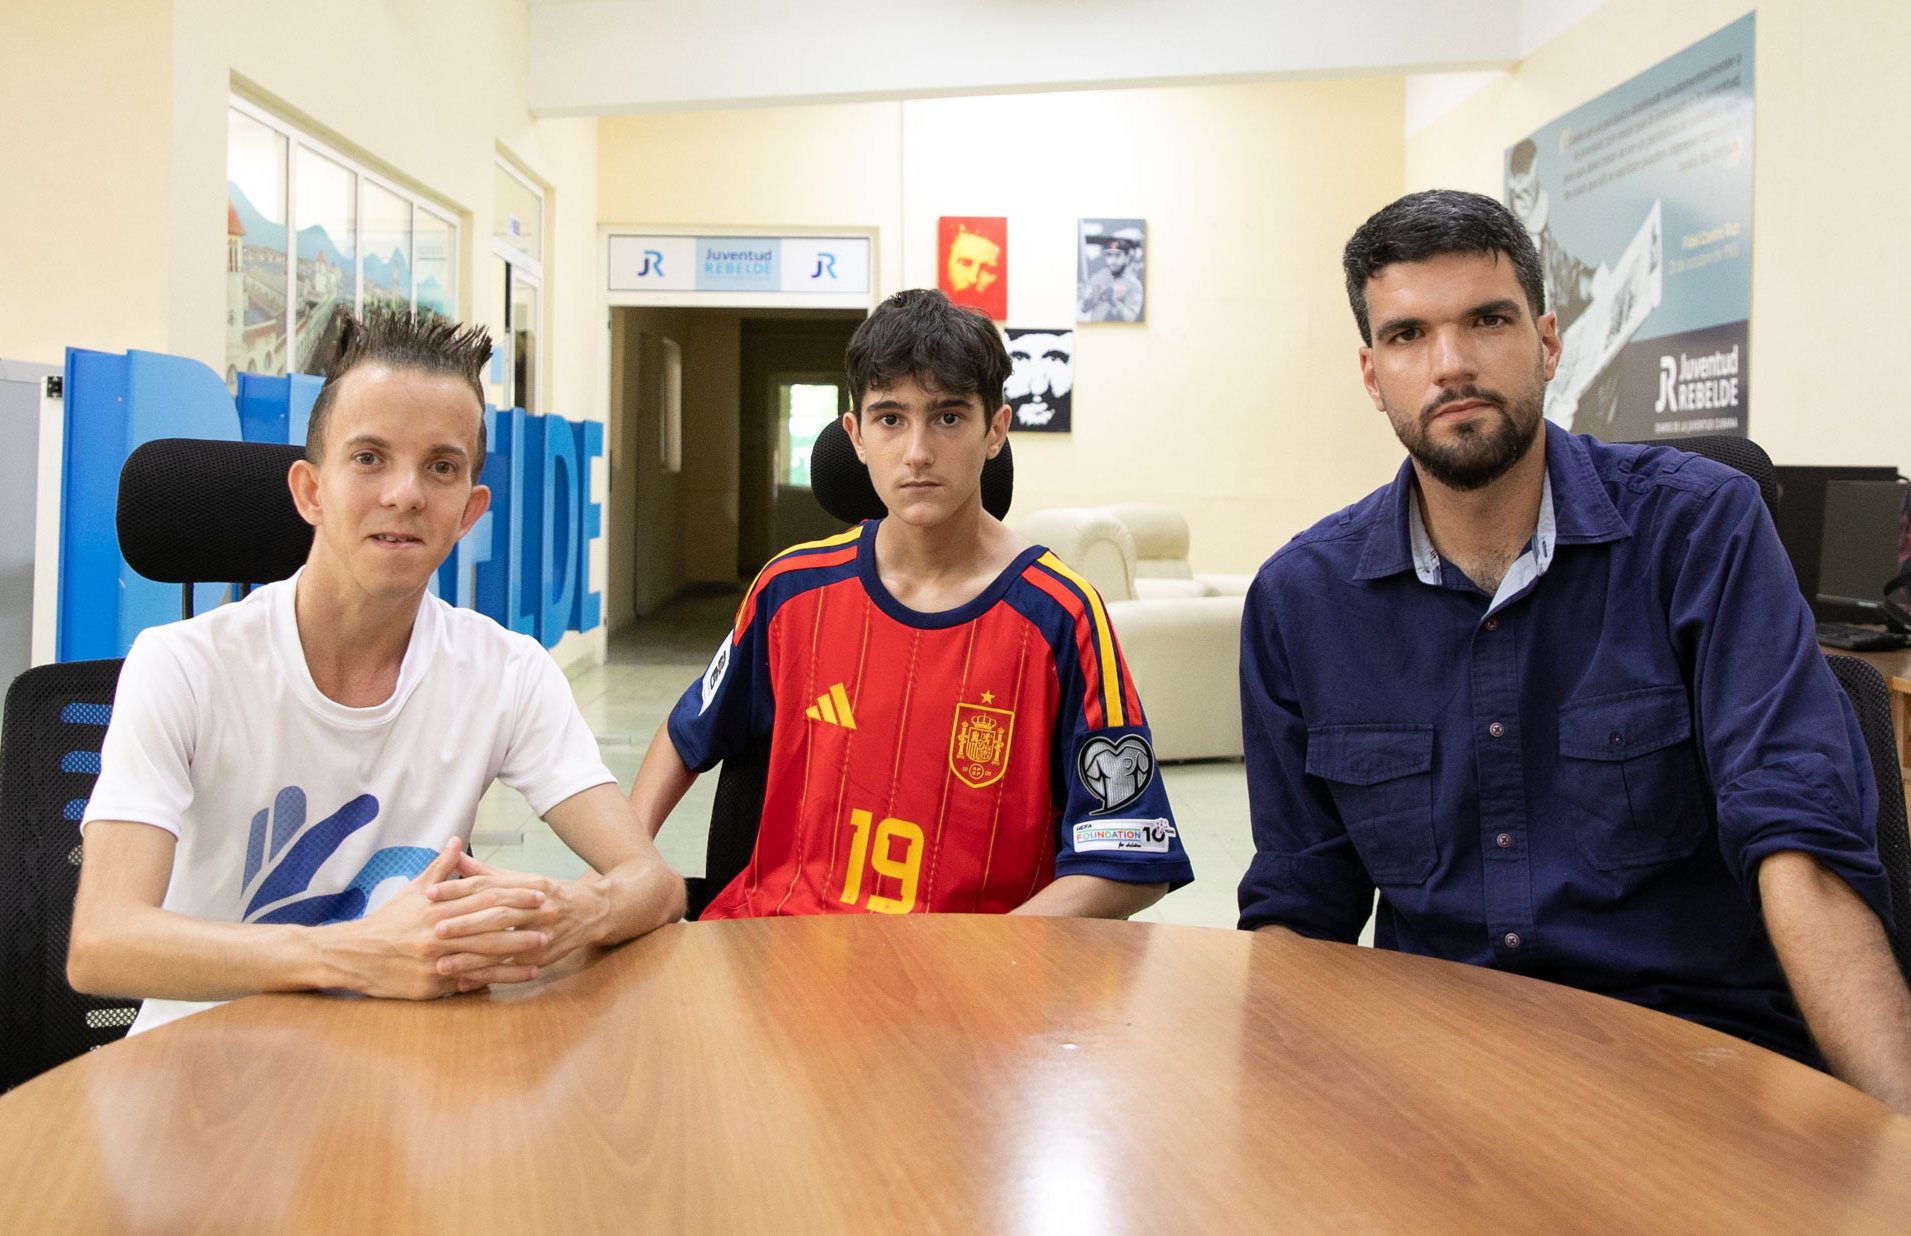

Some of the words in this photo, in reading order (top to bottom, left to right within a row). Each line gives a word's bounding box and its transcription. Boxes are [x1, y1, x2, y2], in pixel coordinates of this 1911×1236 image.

[705, 248, 773, 261] Juventud
[704, 262, 772, 275] REBELDE
[1678, 344, 1739, 381] Juventud
[1678, 377, 1739, 411] REBELDE
[1076, 830, 1141, 841] FOUNDATION
[1142, 826, 1166, 842] 10
[840, 808, 924, 914] 19
